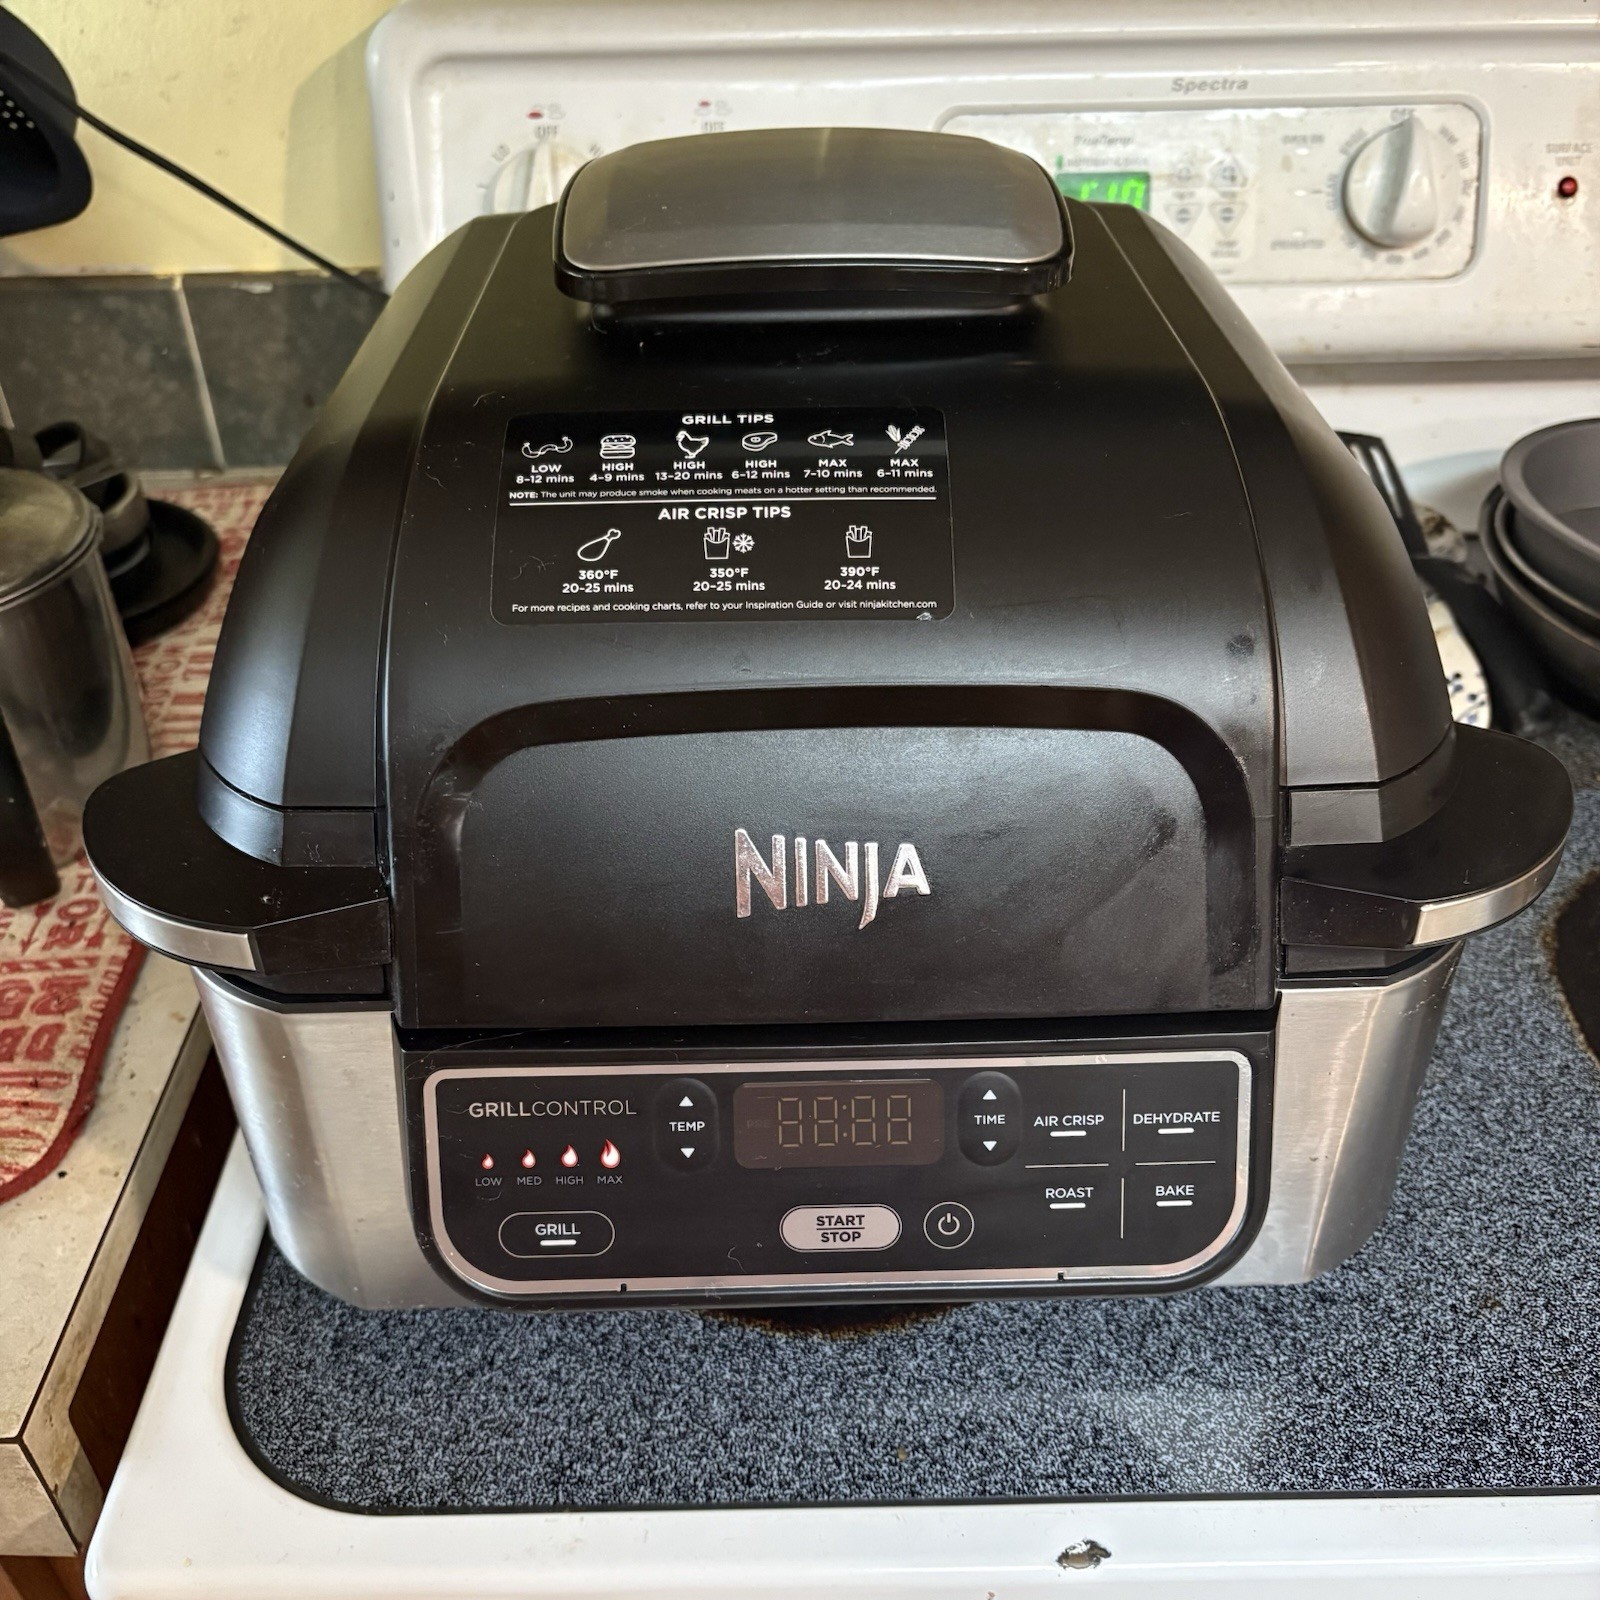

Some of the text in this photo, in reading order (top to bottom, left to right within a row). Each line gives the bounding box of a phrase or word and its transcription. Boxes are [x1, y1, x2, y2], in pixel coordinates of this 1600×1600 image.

[1171, 77, 1249, 95] Spectra
[681, 413, 774, 425] GRILL TIPS
[602, 462, 634, 472] HIGH
[673, 460, 706, 470] HIGH
[745, 459, 777, 469] HIGH
[818, 458, 847, 468] MAX
[890, 458, 919, 467] MAX
[531, 464, 562, 473] LOW
[731, 469, 791, 479] 6-12 mins
[803, 468, 863, 478] 7-10 mins
[876, 468, 934, 478] 6-11 mins
[515, 473, 575, 484] 8-12 mins
[589, 472, 645, 482] 4-9 mins
[655, 471, 723, 481] 13-20 mins
[508, 491, 539, 499] NOTE:
[578, 491, 598, 499] may
[599, 489, 637, 498] produce
[638, 488, 669, 496] smoke
[669, 488, 695, 496] when
[696, 487, 732, 496] cooking
[734, 487, 762, 495] meats
[785, 486, 813, 494] hotter
[814, 486, 846, 494] setting
[847, 485, 868, 493] than
[869, 485, 937, 493] recommended.
[658, 505, 792, 520] AIR CRISP TIPS
[578, 569, 619, 580] 360°F
[709, 567, 749, 579] 350°F
[840, 566, 880, 577] 390°F
[562, 582, 634, 594] 20-25 mins
[693, 580, 766, 592] 20-25 mins
[824, 579, 896, 591] 20-24 mins
[512, 599, 937, 613] For more recipes and cooking charts, refer to your Inspiration Guide or visit ninjakitchen.com
[735, 828, 931, 929] NINJA
[974, 1114, 1006, 1125] TIME
[1033, 1114, 1105, 1127] AIR CRISP
[1133, 1111, 1221, 1125] DEHYDRATE
[669, 1121, 706, 1132] TEMP
[475, 1176, 503, 1187] LOW
[516, 1176, 542, 1186] MED
[555, 1175, 584, 1185] HIGH
[597, 1175, 623, 1184] MAX
[1045, 1186, 1094, 1199] ROAST
[1155, 1184, 1195, 1197] BAKE
[816, 1214, 865, 1226] START
[535, 1223, 581, 1236] GRILL
[821, 1231, 861, 1243] STOP
